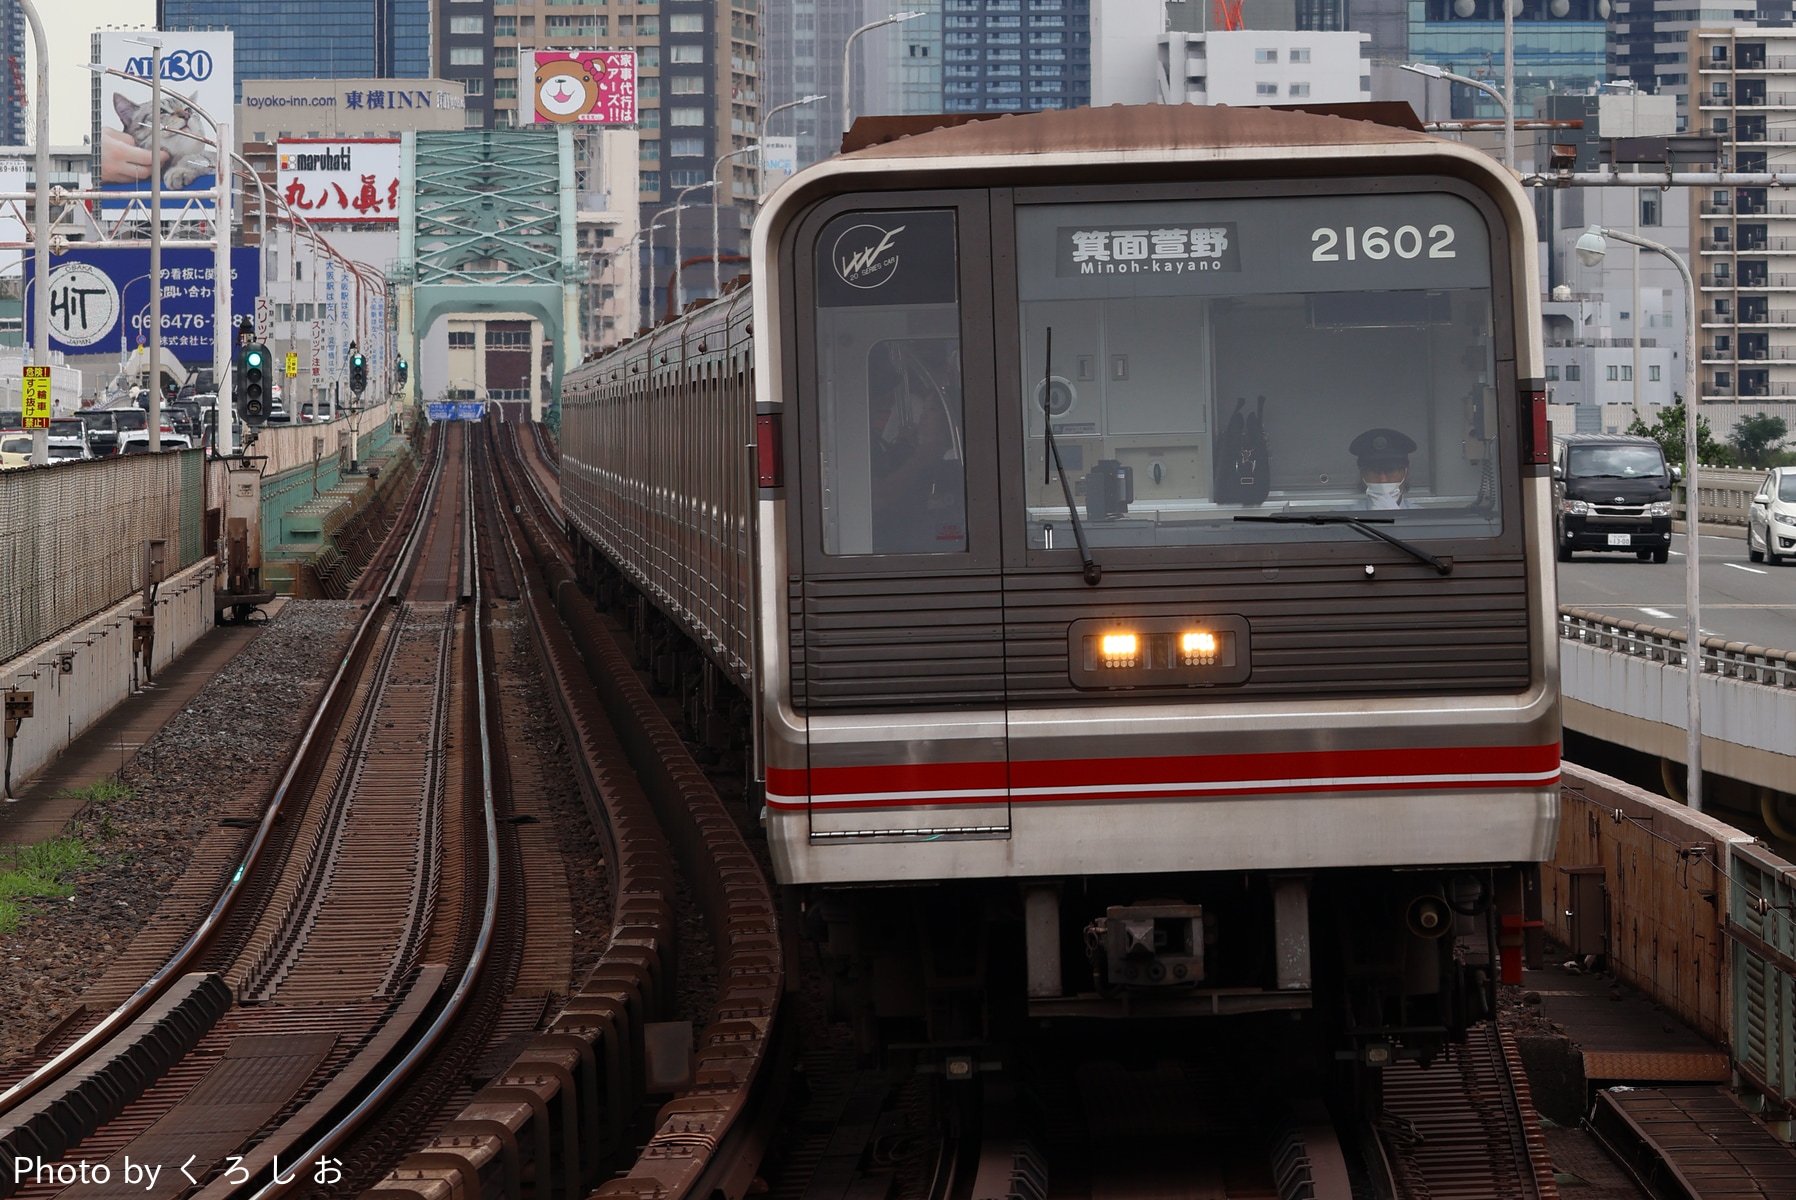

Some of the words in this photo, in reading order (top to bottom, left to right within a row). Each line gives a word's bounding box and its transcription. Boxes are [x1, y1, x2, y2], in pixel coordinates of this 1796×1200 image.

[126, 50, 212, 81] AIM30
[345, 90, 432, 110] 東横INN
[607, 54, 620, 122] ベアーズ!!
[620, 54, 632, 121] 家事代行は
[247, 95, 337, 110] toyoko-inn.com
[297, 146, 351, 171] maruhati
[1072, 228, 1228, 262] 箕面萱野
[1311, 224, 1457, 262] 21602
[65, 265, 93, 273] OSAKA
[850, 272, 859, 281] 20
[861, 262, 882, 276] SERIES
[883, 256, 896, 267] CAR
[1081, 260, 1221, 275] Minoh-kayano
[67, 337, 91, 345] JAPAN
[26, 378, 36, 416] すり抜け
[37, 378, 47, 411] 二輪車
[62, 656, 72, 672] 5
